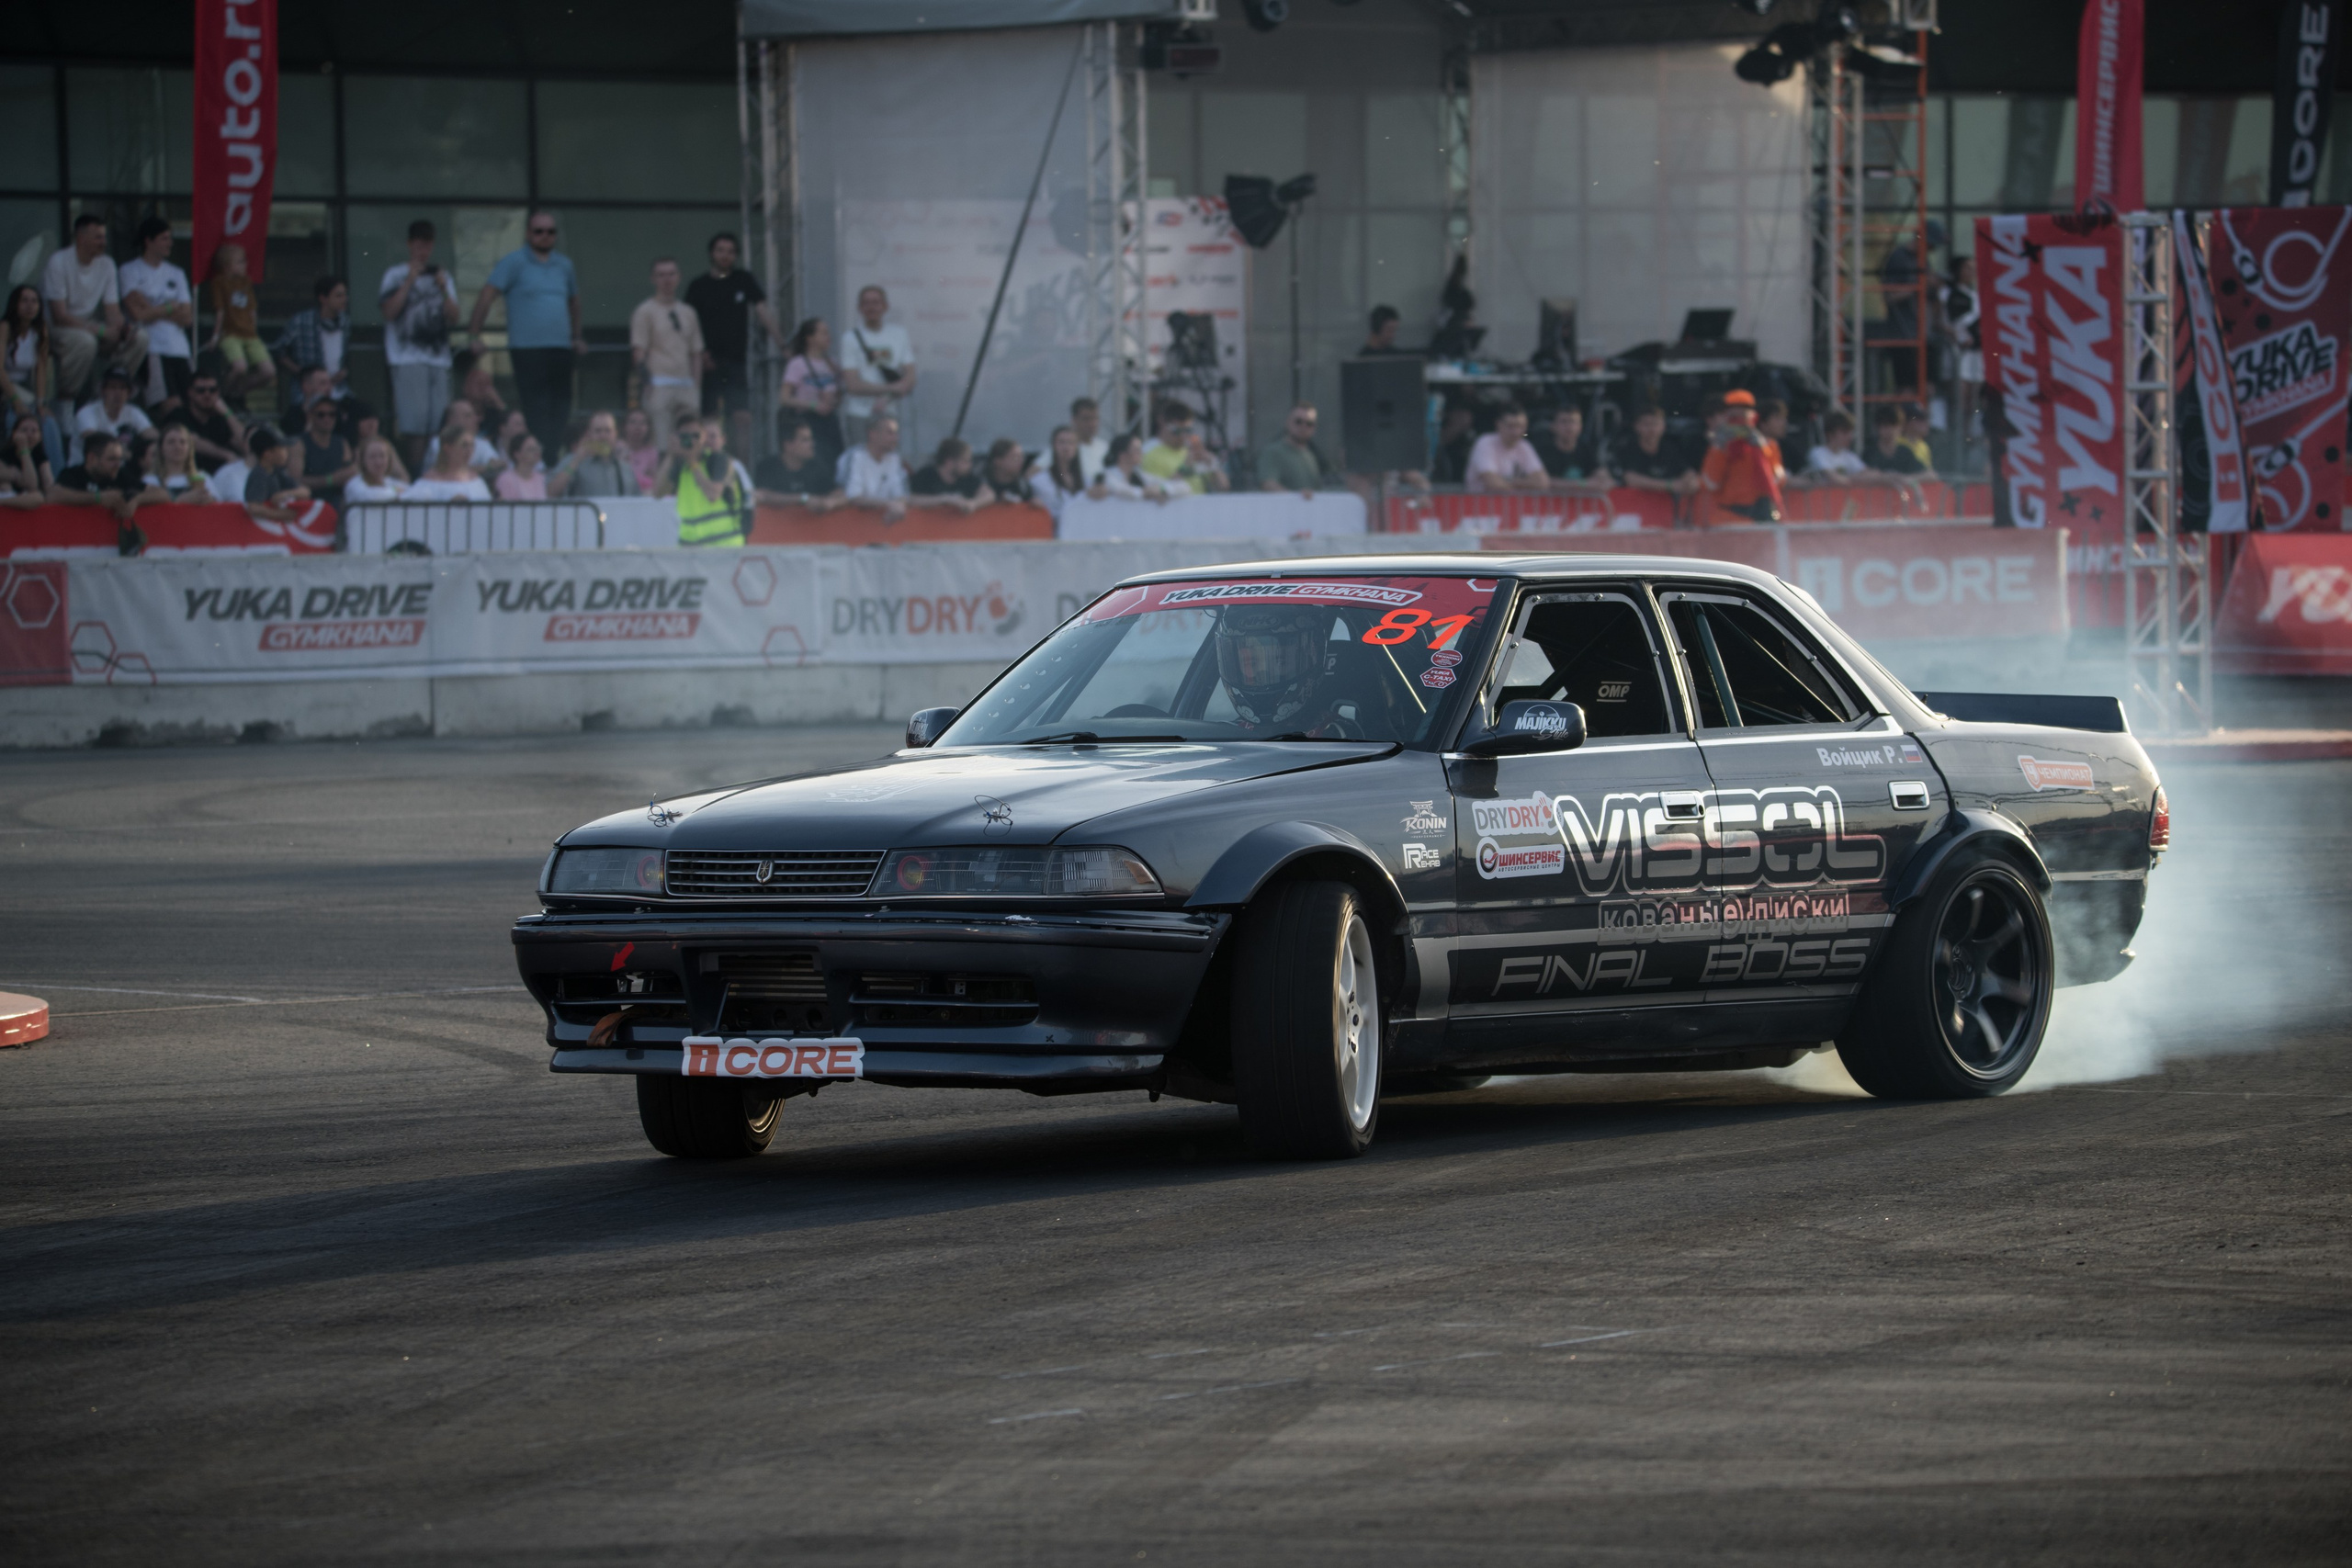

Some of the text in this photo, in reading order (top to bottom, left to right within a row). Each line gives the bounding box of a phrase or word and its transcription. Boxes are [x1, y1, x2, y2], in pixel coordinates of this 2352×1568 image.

[220, 0, 264, 236] auto.r
[1990, 216, 2047, 529] GYMKHANA
[2042, 246, 2119, 496] YUKA
[185, 584, 432, 621] YUKA DRIVE
[477, 579, 707, 612] YUKA DRIVE
[1166, 585, 1408, 603] YUKA DRIVE GYMKHANA
[832, 595, 979, 635] DRYDRY
[266, 625, 419, 647] GYMKHANA
[551, 617, 691, 639] GYMKHANA
[1362, 607, 1475, 650] 81
[1423, 673, 1453, 682] G-TAXI
[1598, 684, 1630, 698] OMP
[1514, 716, 1566, 730] MAJIKKU
[1816, 745, 1903, 769] Войцик Р.
[2038, 766, 2090, 781] ЧЕМПИОНАТ
[1399, 817, 1447, 832] RONIN
[1475, 806, 1540, 829] DRYDRY
[1554, 786, 1886, 897] VISSOL
[1498, 851, 1561, 866] ШИНСЕРВИС
[1600, 889, 1849, 942] кованые диски
[1492, 938, 1871, 997] FINAL BOSS
